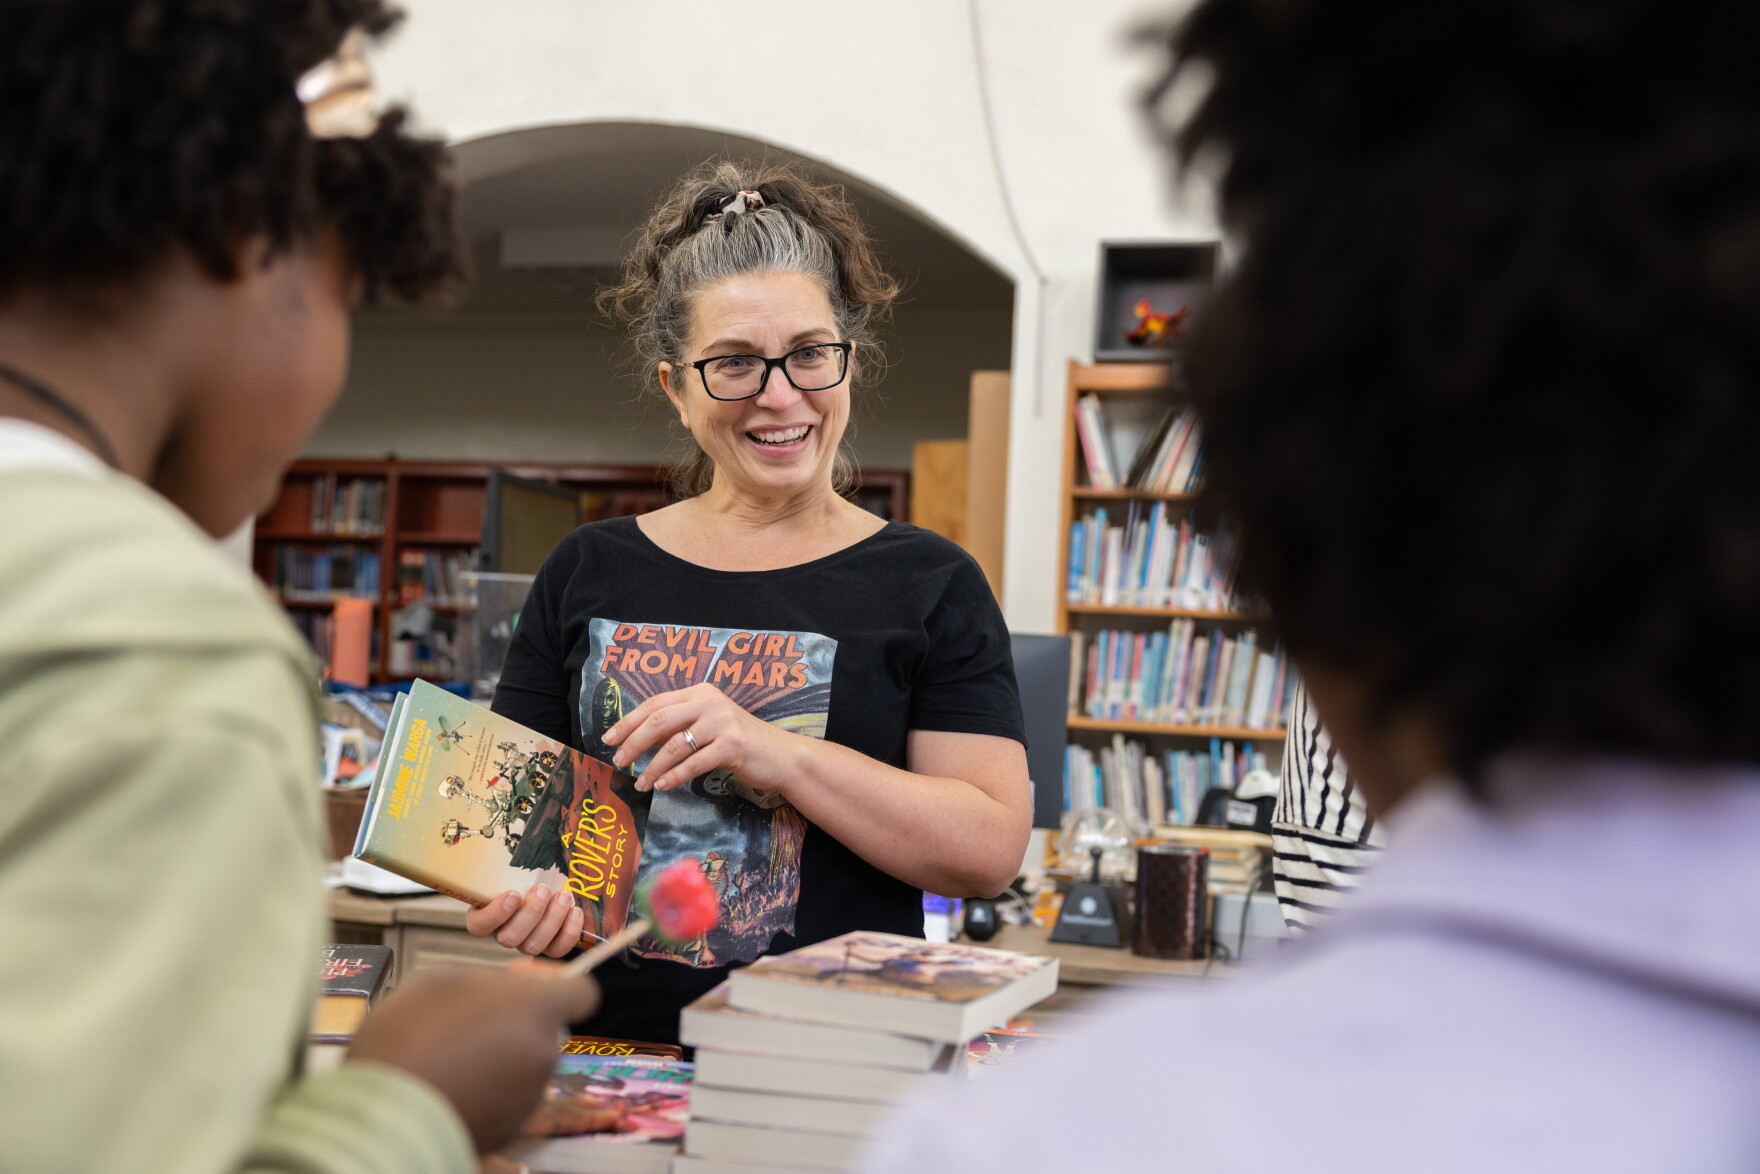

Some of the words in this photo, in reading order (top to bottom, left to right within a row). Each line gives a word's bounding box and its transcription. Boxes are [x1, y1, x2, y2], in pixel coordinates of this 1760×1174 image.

[612, 624, 717, 652] DEVIL
[727, 632, 805, 658] GIRL
[600, 646, 698, 679] FROM
[713, 659, 808, 688] MARS
[387, 762, 413, 820] JASMINE
[403, 718, 428, 762] WARGA
[561, 832, 573, 848] A
[606, 824, 629, 898] STORY
